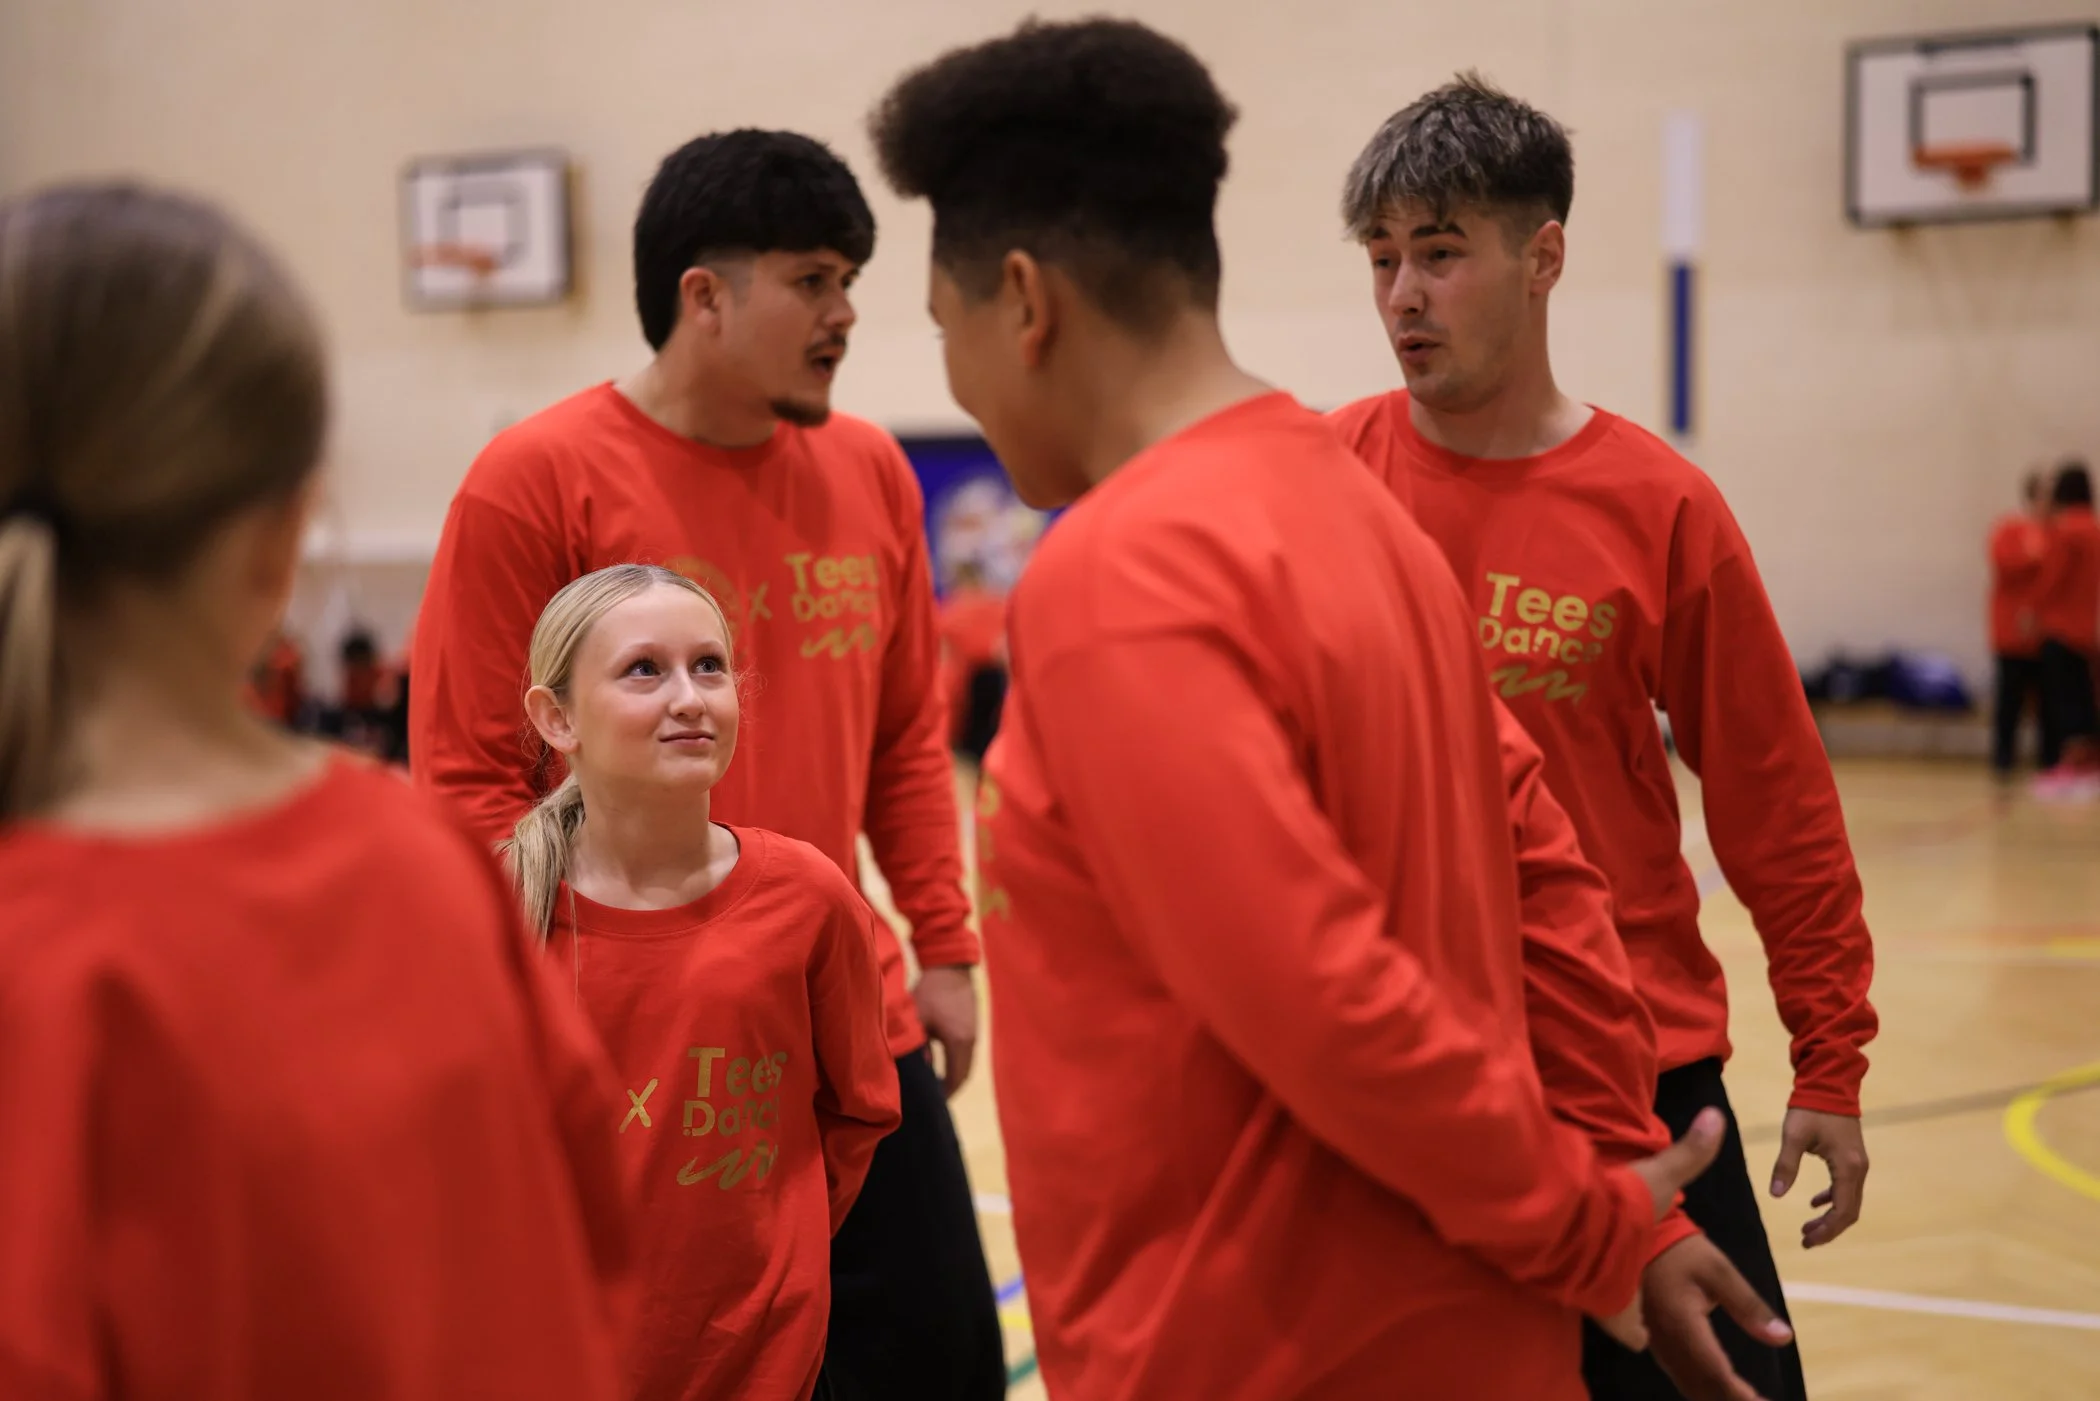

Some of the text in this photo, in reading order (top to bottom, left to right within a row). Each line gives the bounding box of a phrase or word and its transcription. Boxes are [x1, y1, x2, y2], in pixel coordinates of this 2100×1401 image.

[790, 591, 877, 622] Dac
[1486, 572, 1617, 639] Tees
[687, 1047, 788, 1097] Tees
[683, 1097, 779, 1137] Danc
